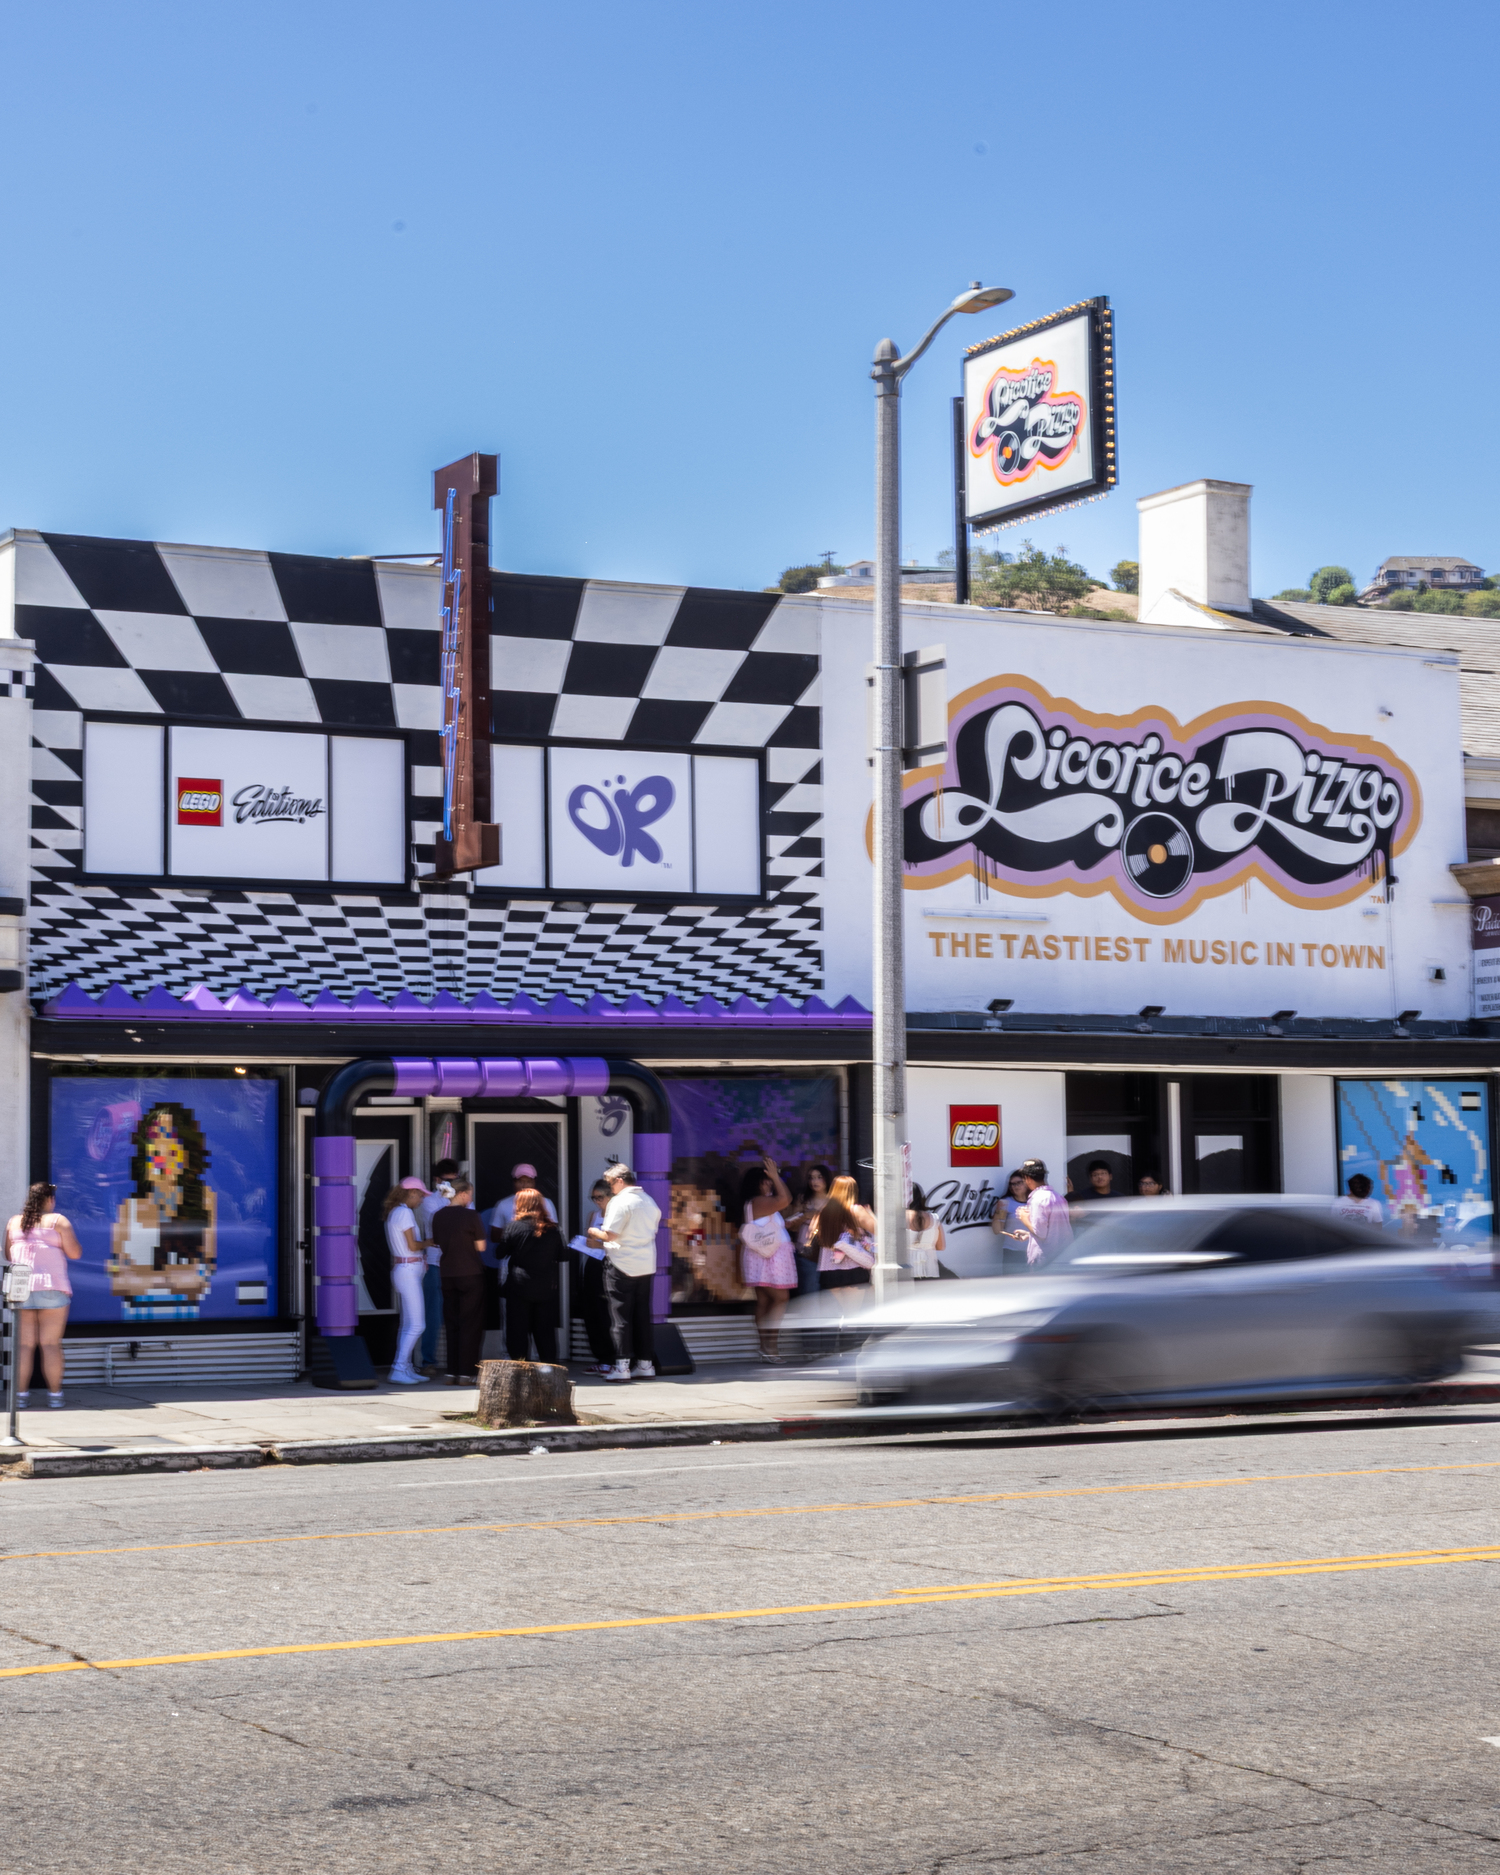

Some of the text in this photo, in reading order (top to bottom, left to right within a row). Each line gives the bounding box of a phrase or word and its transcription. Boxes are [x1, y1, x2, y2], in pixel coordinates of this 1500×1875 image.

[979, 368, 1052, 438] Licorice
[1021, 402, 1080, 460] Pizza
[179, 784, 326, 824] LEGO Editions
[920, 704, 1400, 865] Licorice Pizza
[929, 931, 1386, 969] THE TASTIEST MUSIC IN TOWN
[953, 1124, 999, 1148] LEGO
